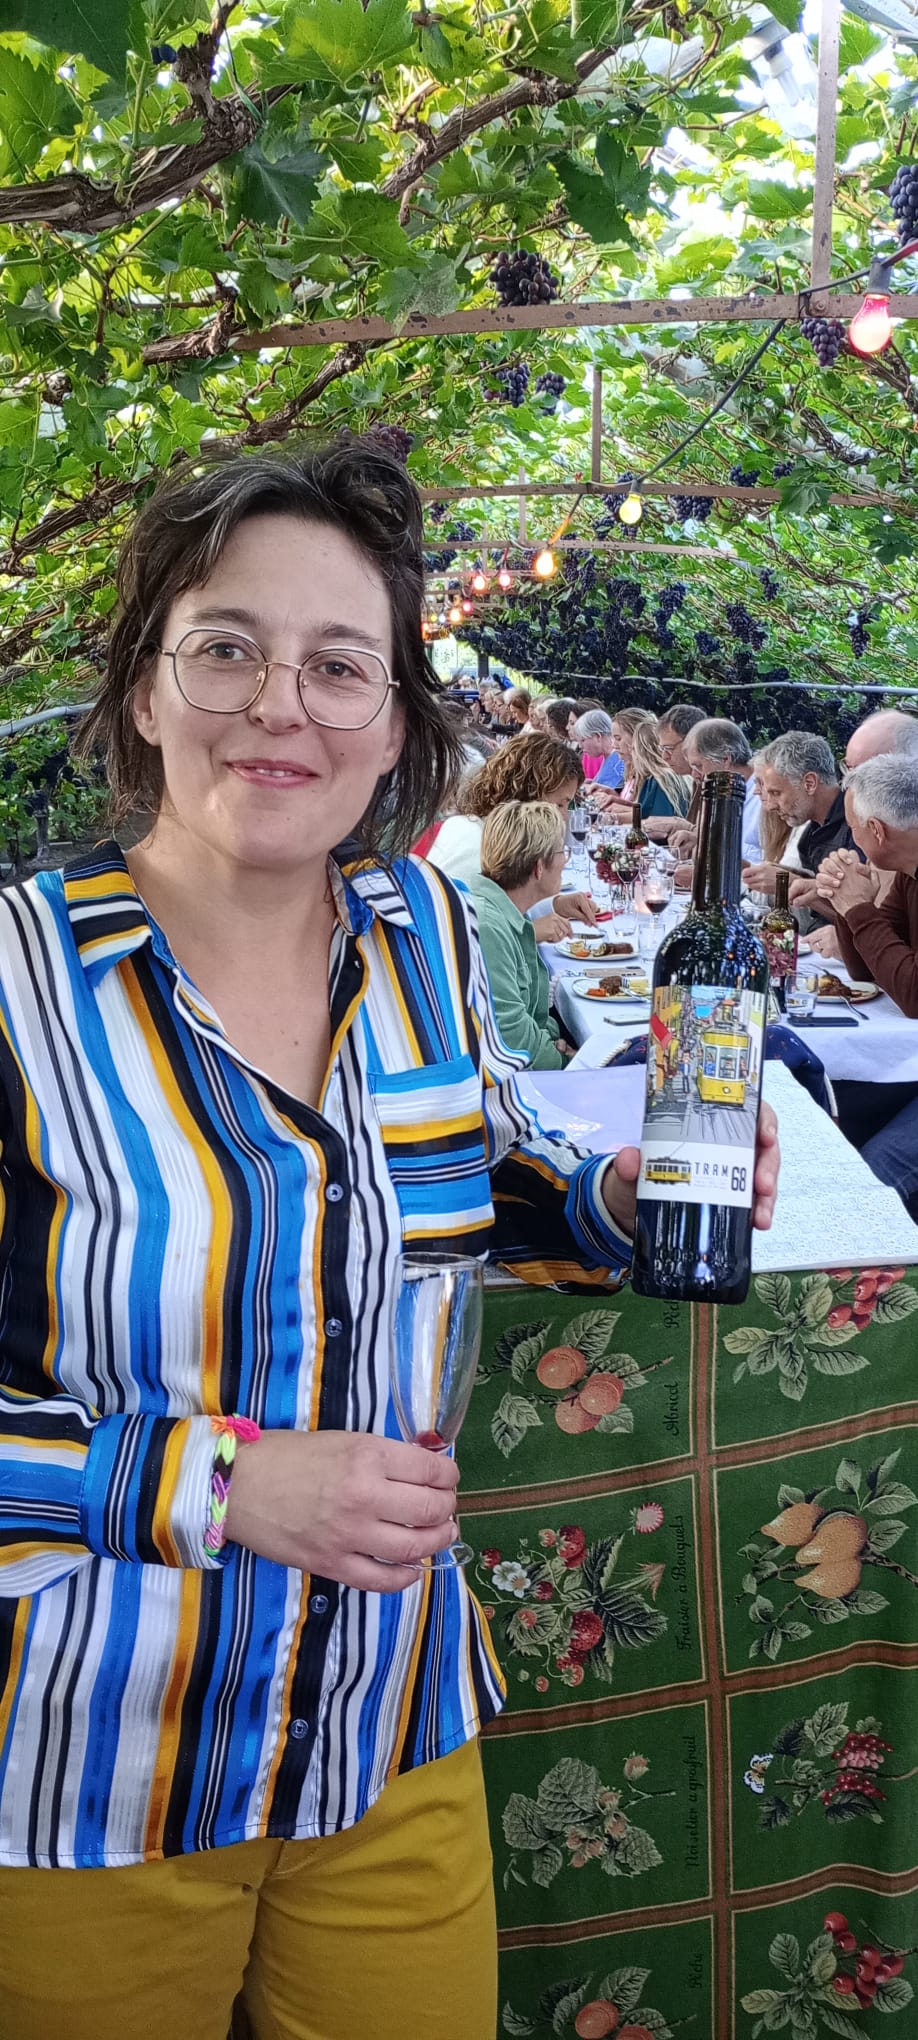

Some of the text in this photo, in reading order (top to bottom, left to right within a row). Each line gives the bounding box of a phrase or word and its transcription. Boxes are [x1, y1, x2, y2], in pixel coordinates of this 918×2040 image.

[694, 1161, 729, 1178] TRAM
[731, 1166, 747, 1192] 68
[669, 1515, 691, 1581] Bouquets
[674, 1598, 692, 1651] Fraisier
